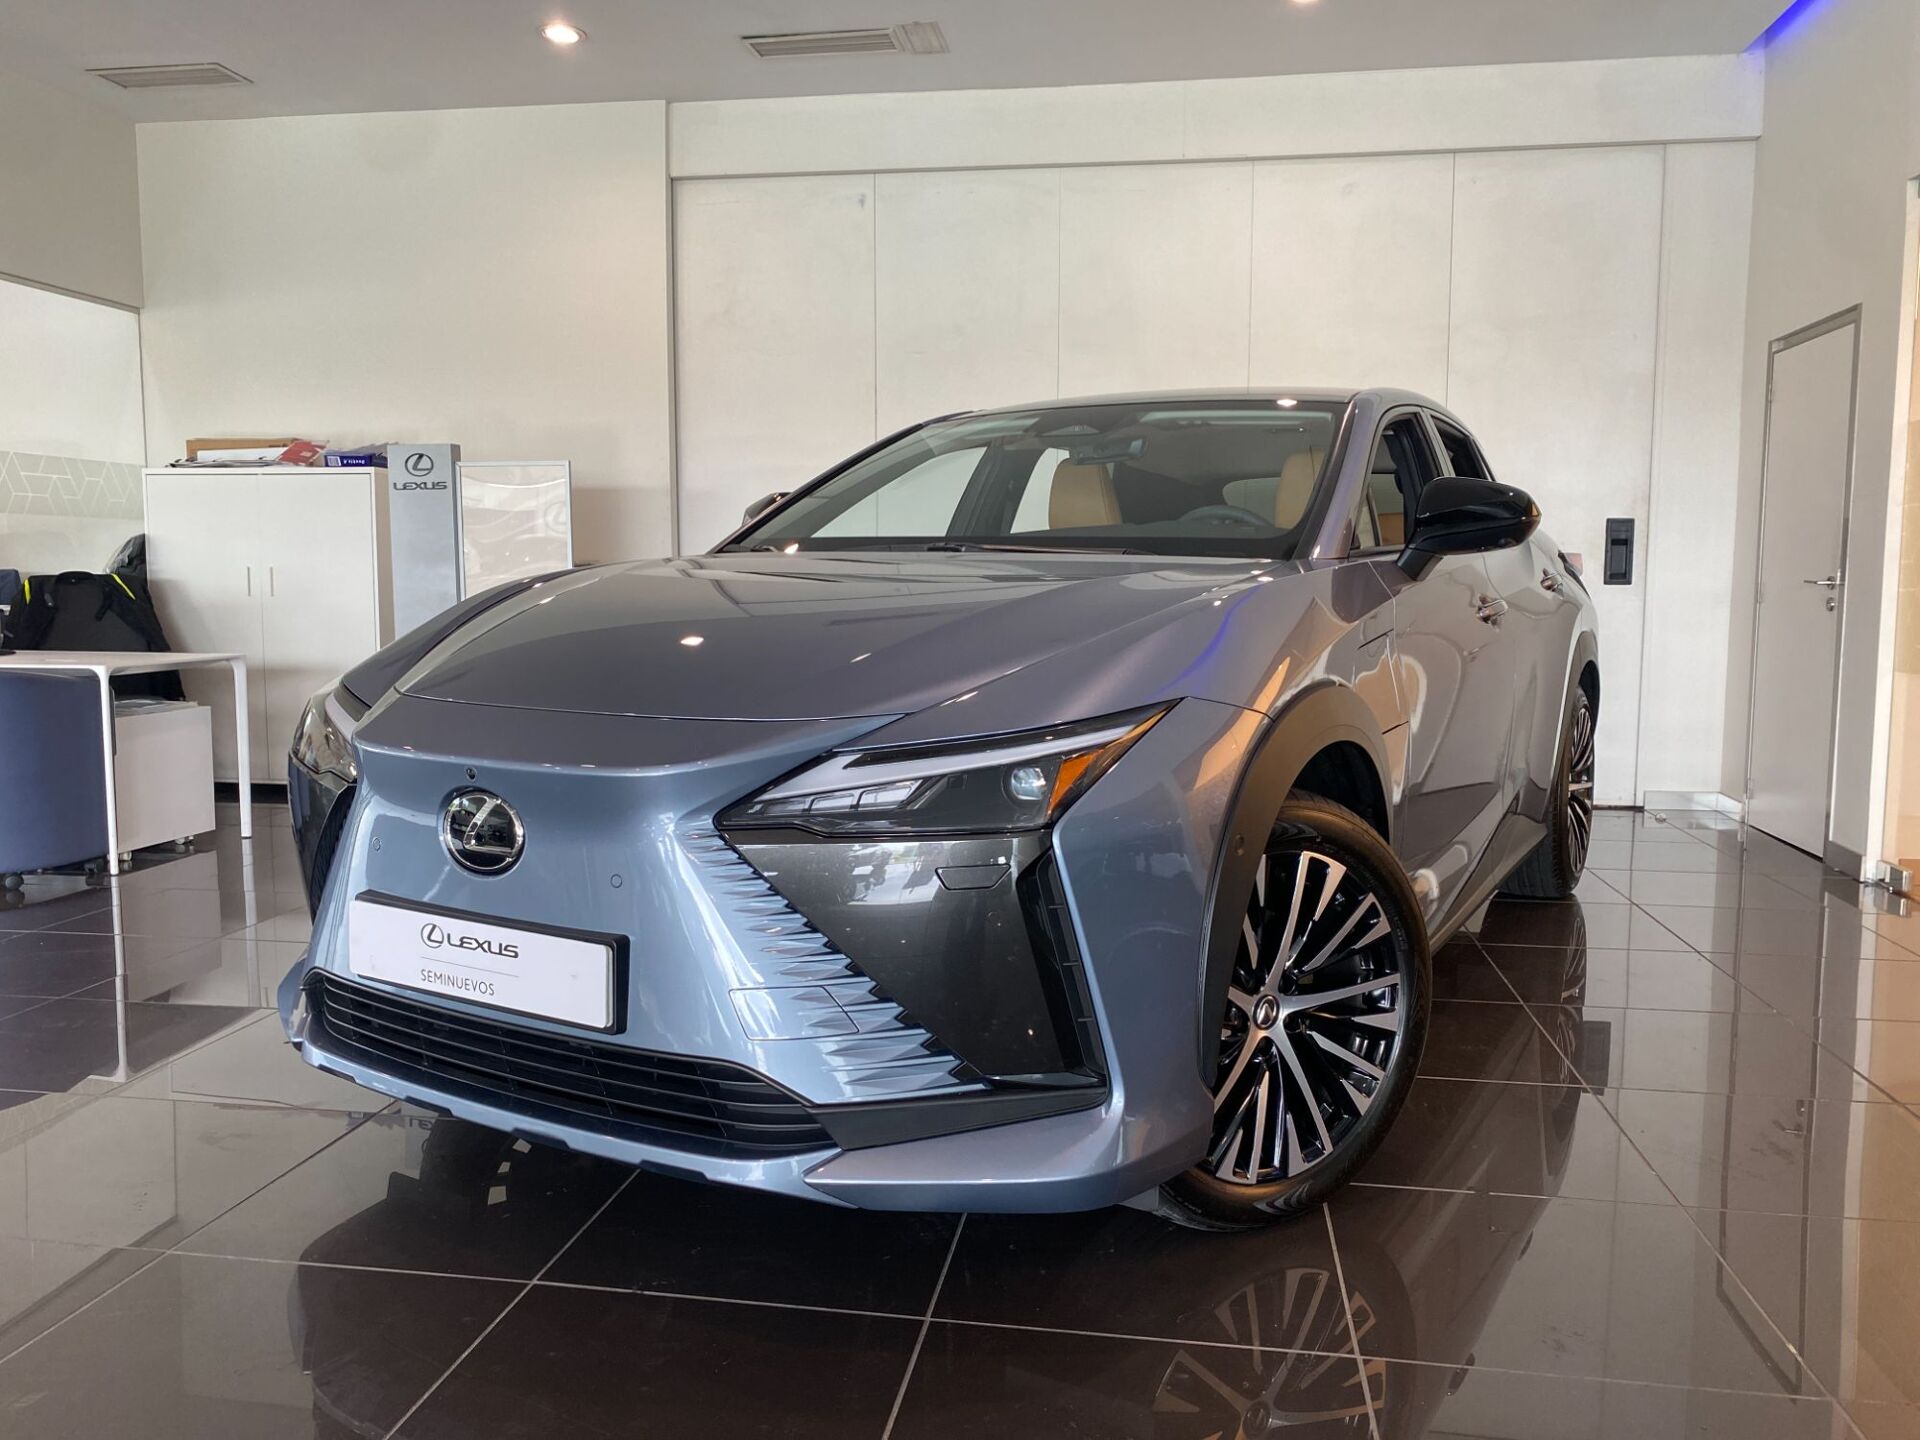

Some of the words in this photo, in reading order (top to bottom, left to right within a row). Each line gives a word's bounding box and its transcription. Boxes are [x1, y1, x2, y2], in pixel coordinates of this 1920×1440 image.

[393, 481, 448, 490] LEXUS
[447, 933, 518, 958] LEXUS
[420, 969, 495, 996] SEMINUEVOS
